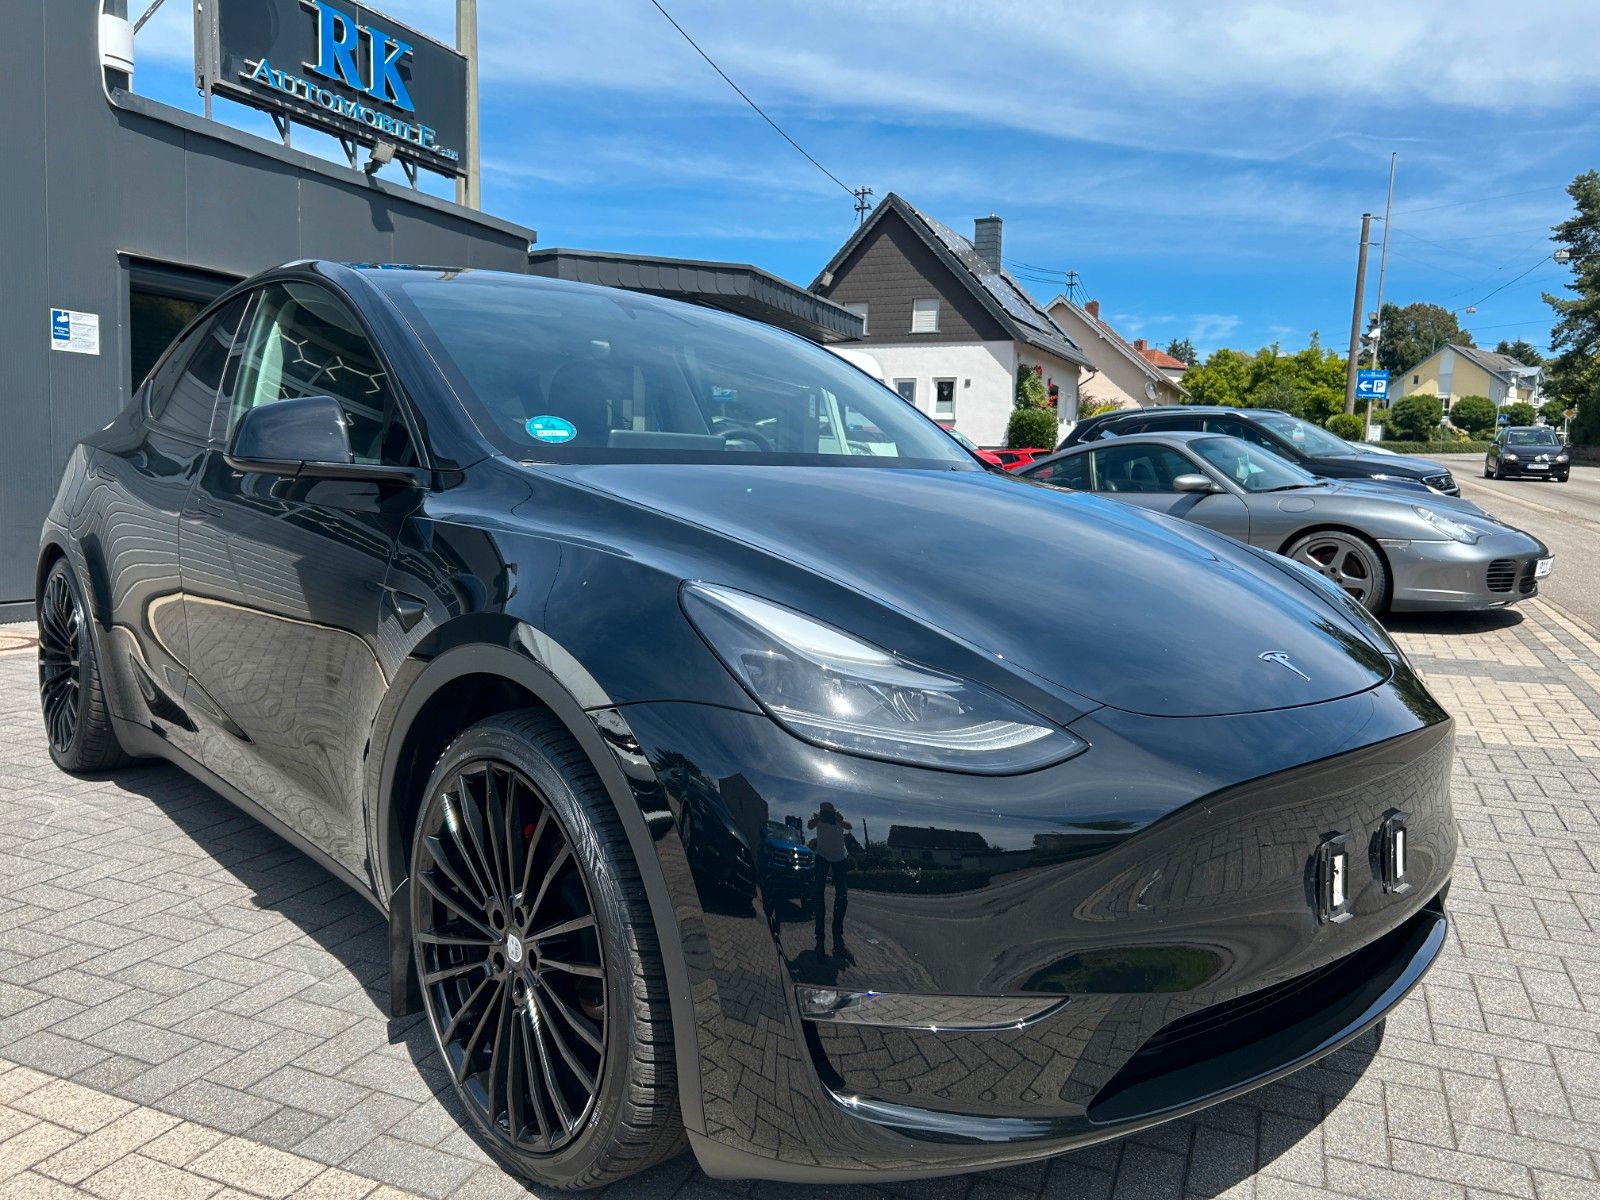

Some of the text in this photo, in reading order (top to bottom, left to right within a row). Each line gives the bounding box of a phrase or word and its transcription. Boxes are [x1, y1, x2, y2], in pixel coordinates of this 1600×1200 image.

[303, 0, 415, 112] RK
[239, 58, 437, 152] AUTOMOBILE
[1375, 381, 1384, 392] P
